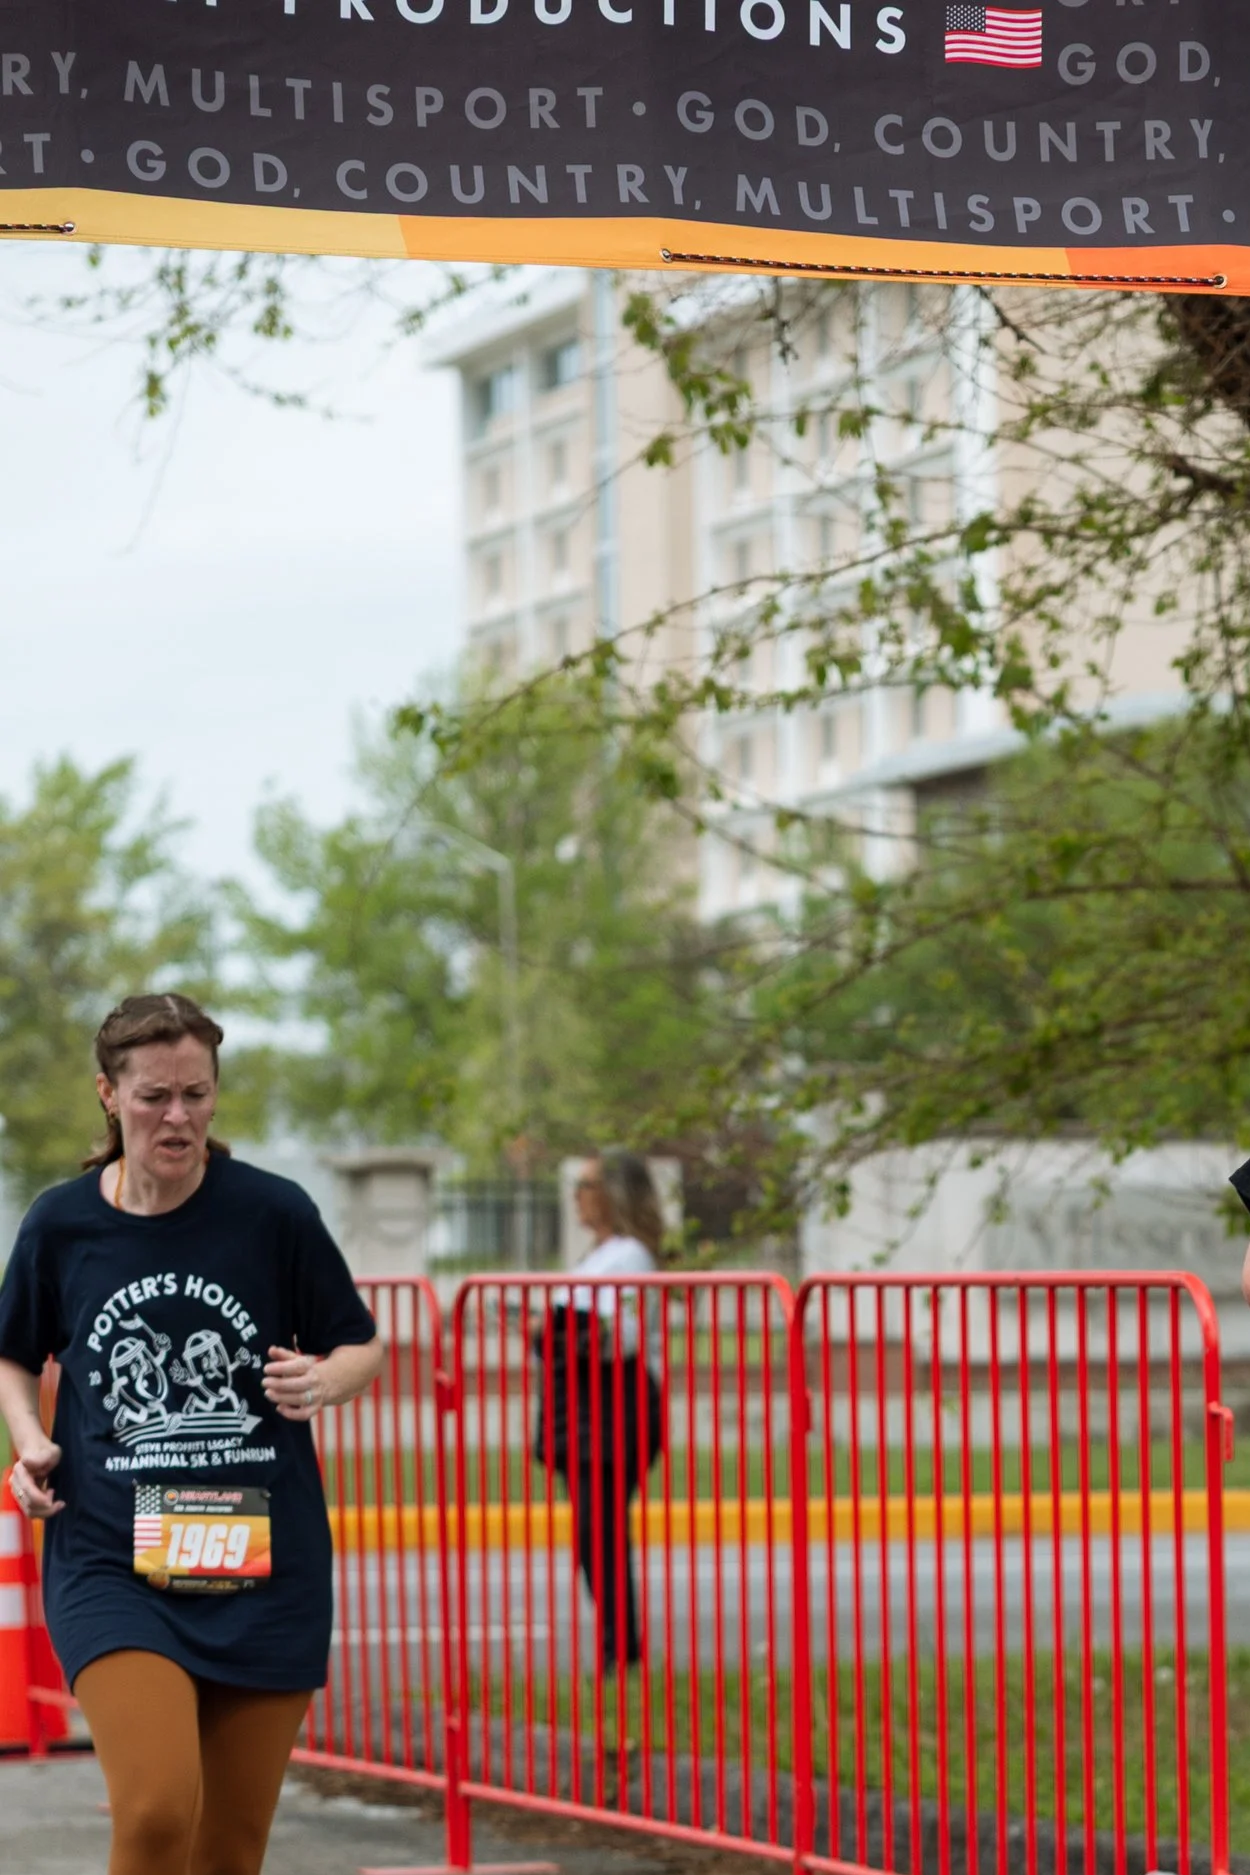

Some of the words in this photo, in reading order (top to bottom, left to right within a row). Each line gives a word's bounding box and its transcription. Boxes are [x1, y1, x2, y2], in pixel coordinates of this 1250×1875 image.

[1057, 41, 1221, 87] GOD,
[124, 60, 604, 128] MULTISPORT
[677, 91, 840, 153] GOD,
[874, 113, 1226, 164] COUNTRY,
[126, 140, 300, 199] GOD,
[336, 160, 702, 211] COUNTRY,
[736, 174, 1195, 236] MULTISPORT
[87, 1272, 179, 1353] POTTER'S
[184, 1274, 258, 1343] HOUSE
[190, 1452, 209, 1468] 5K
[211, 1451, 223, 1466] &
[166, 1523, 251, 1570] 1969
